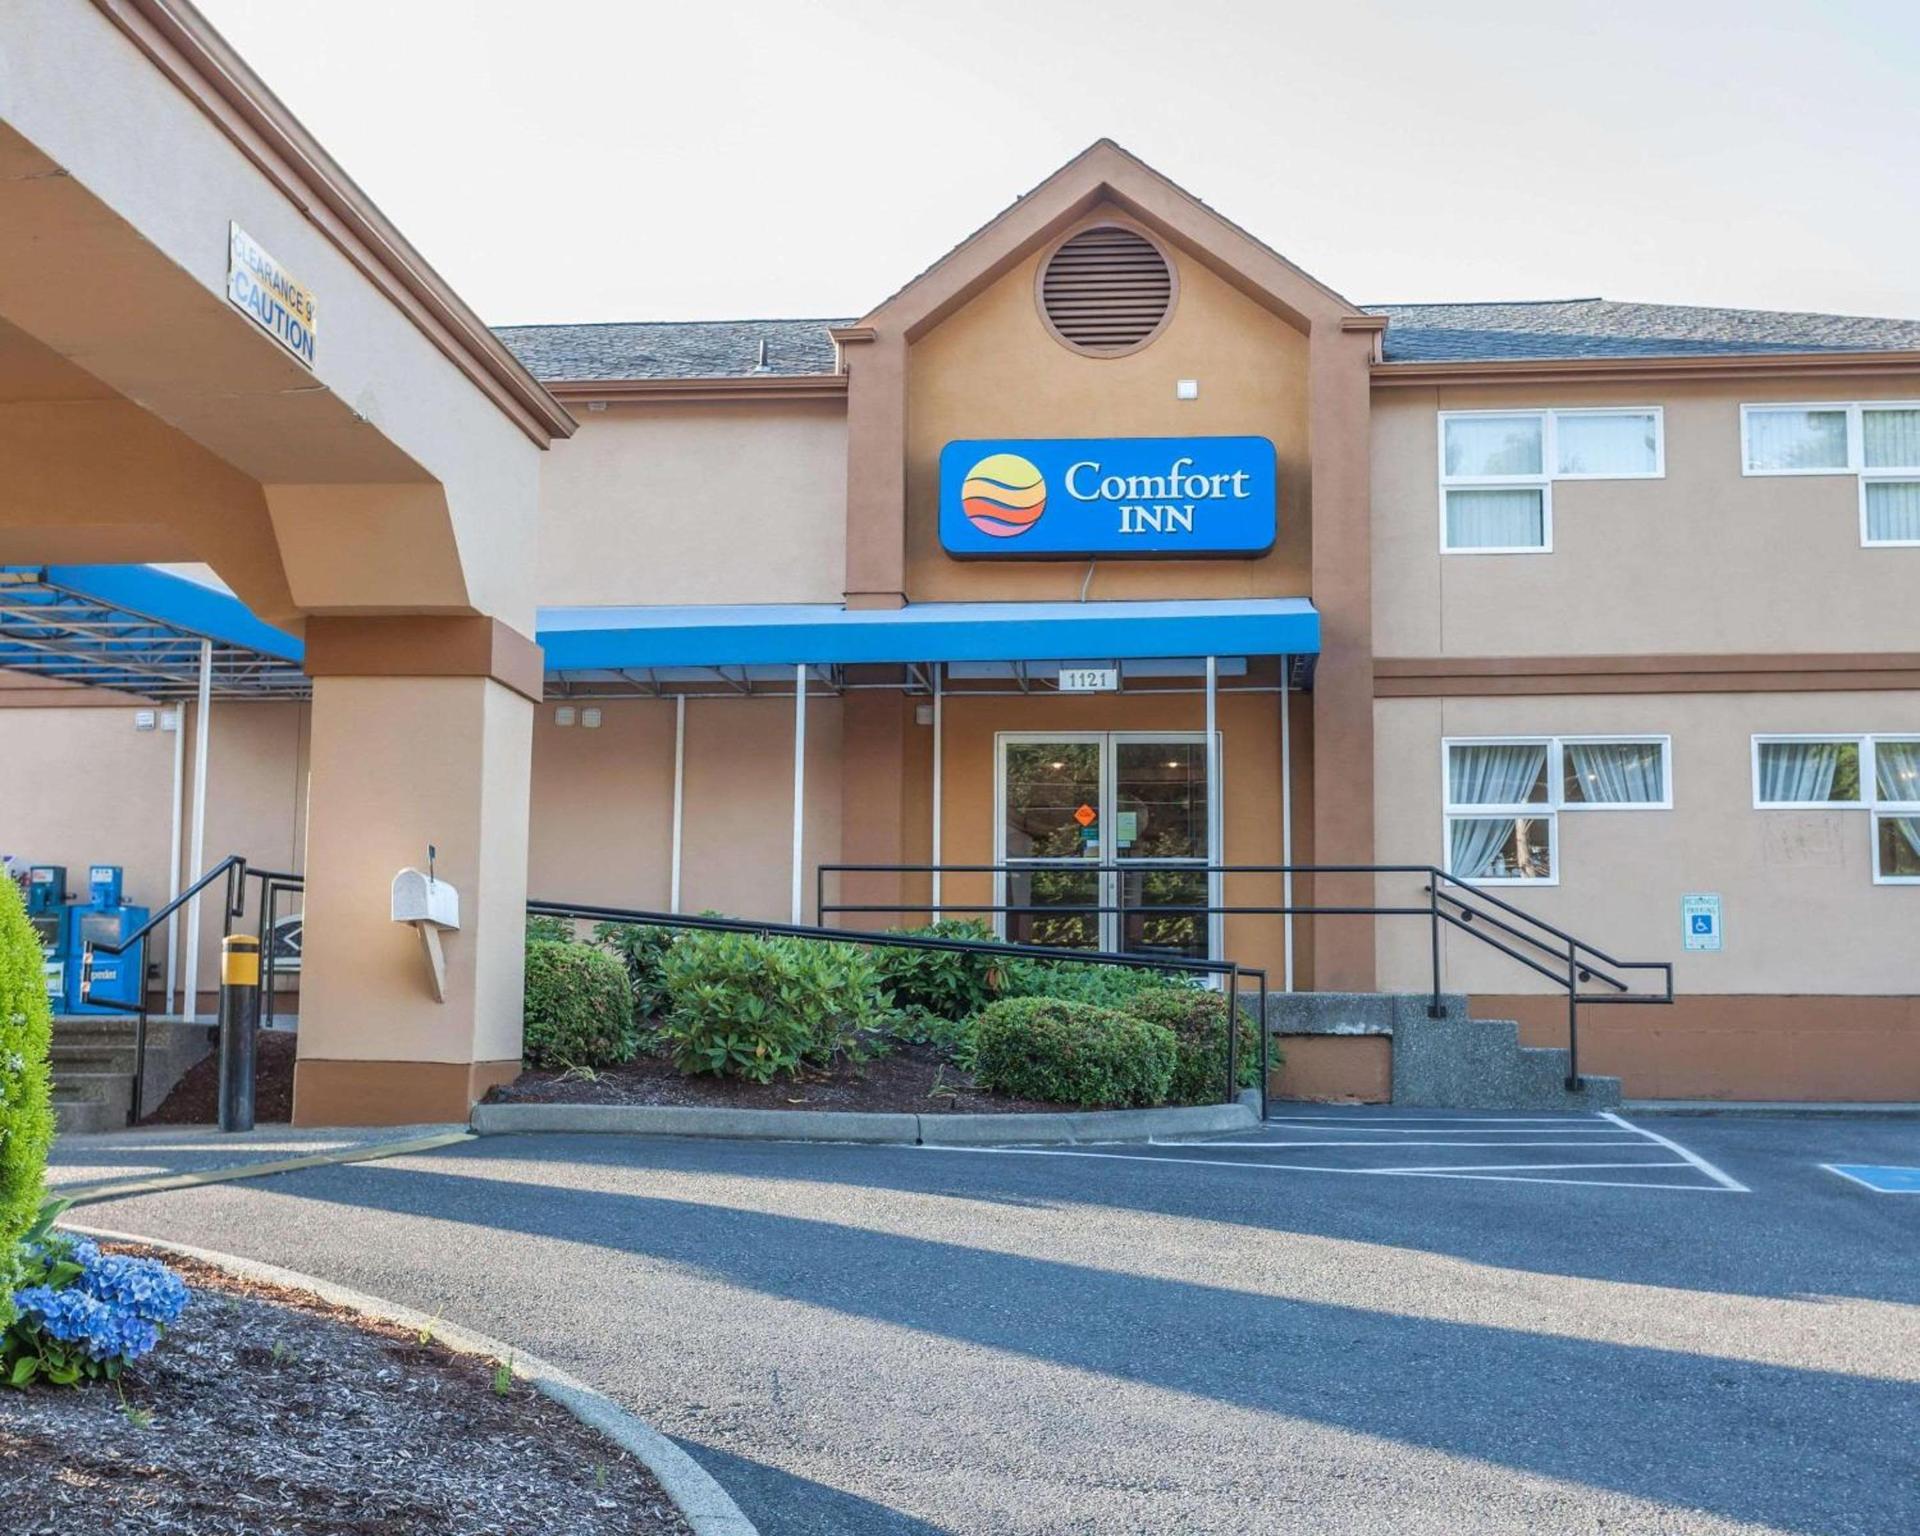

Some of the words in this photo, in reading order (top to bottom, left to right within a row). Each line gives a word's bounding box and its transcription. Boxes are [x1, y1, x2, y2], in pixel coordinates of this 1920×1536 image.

[233, 233, 303, 315] CLEARANCE
[235, 271, 314, 362] CAUTION
[1064, 457, 1250, 501] Comfort
[1118, 505, 1195, 533] INN
[1069, 672, 1106, 687] 1121
